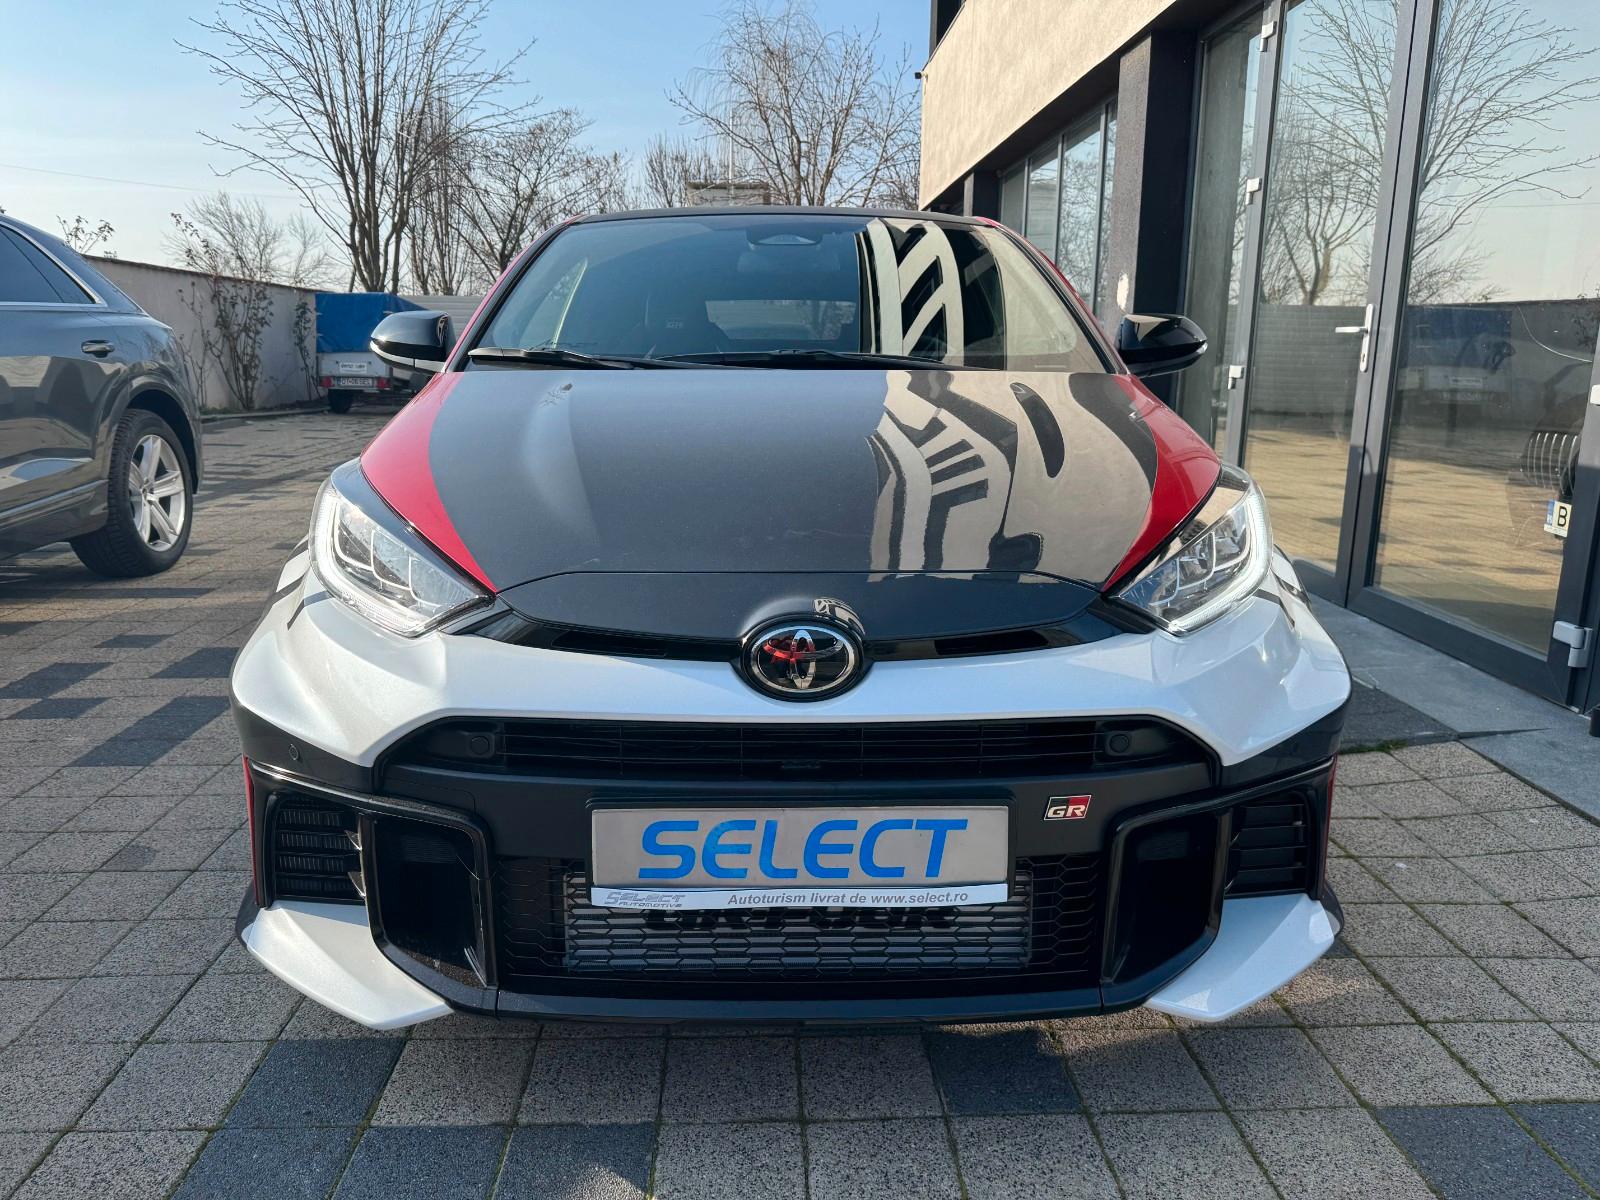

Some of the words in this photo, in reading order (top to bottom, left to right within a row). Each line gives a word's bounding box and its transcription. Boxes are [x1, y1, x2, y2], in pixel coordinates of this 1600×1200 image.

[1557, 506, 1568, 527] B
[1047, 804, 1086, 818] GR
[638, 818, 969, 879] SELECT
[604, 892, 686, 905] SELECT
[728, 893, 806, 905] Autoturism
[810, 892, 844, 904] livrat
[849, 893, 868, 904] de
[871, 892, 969, 905] www.select.ro
